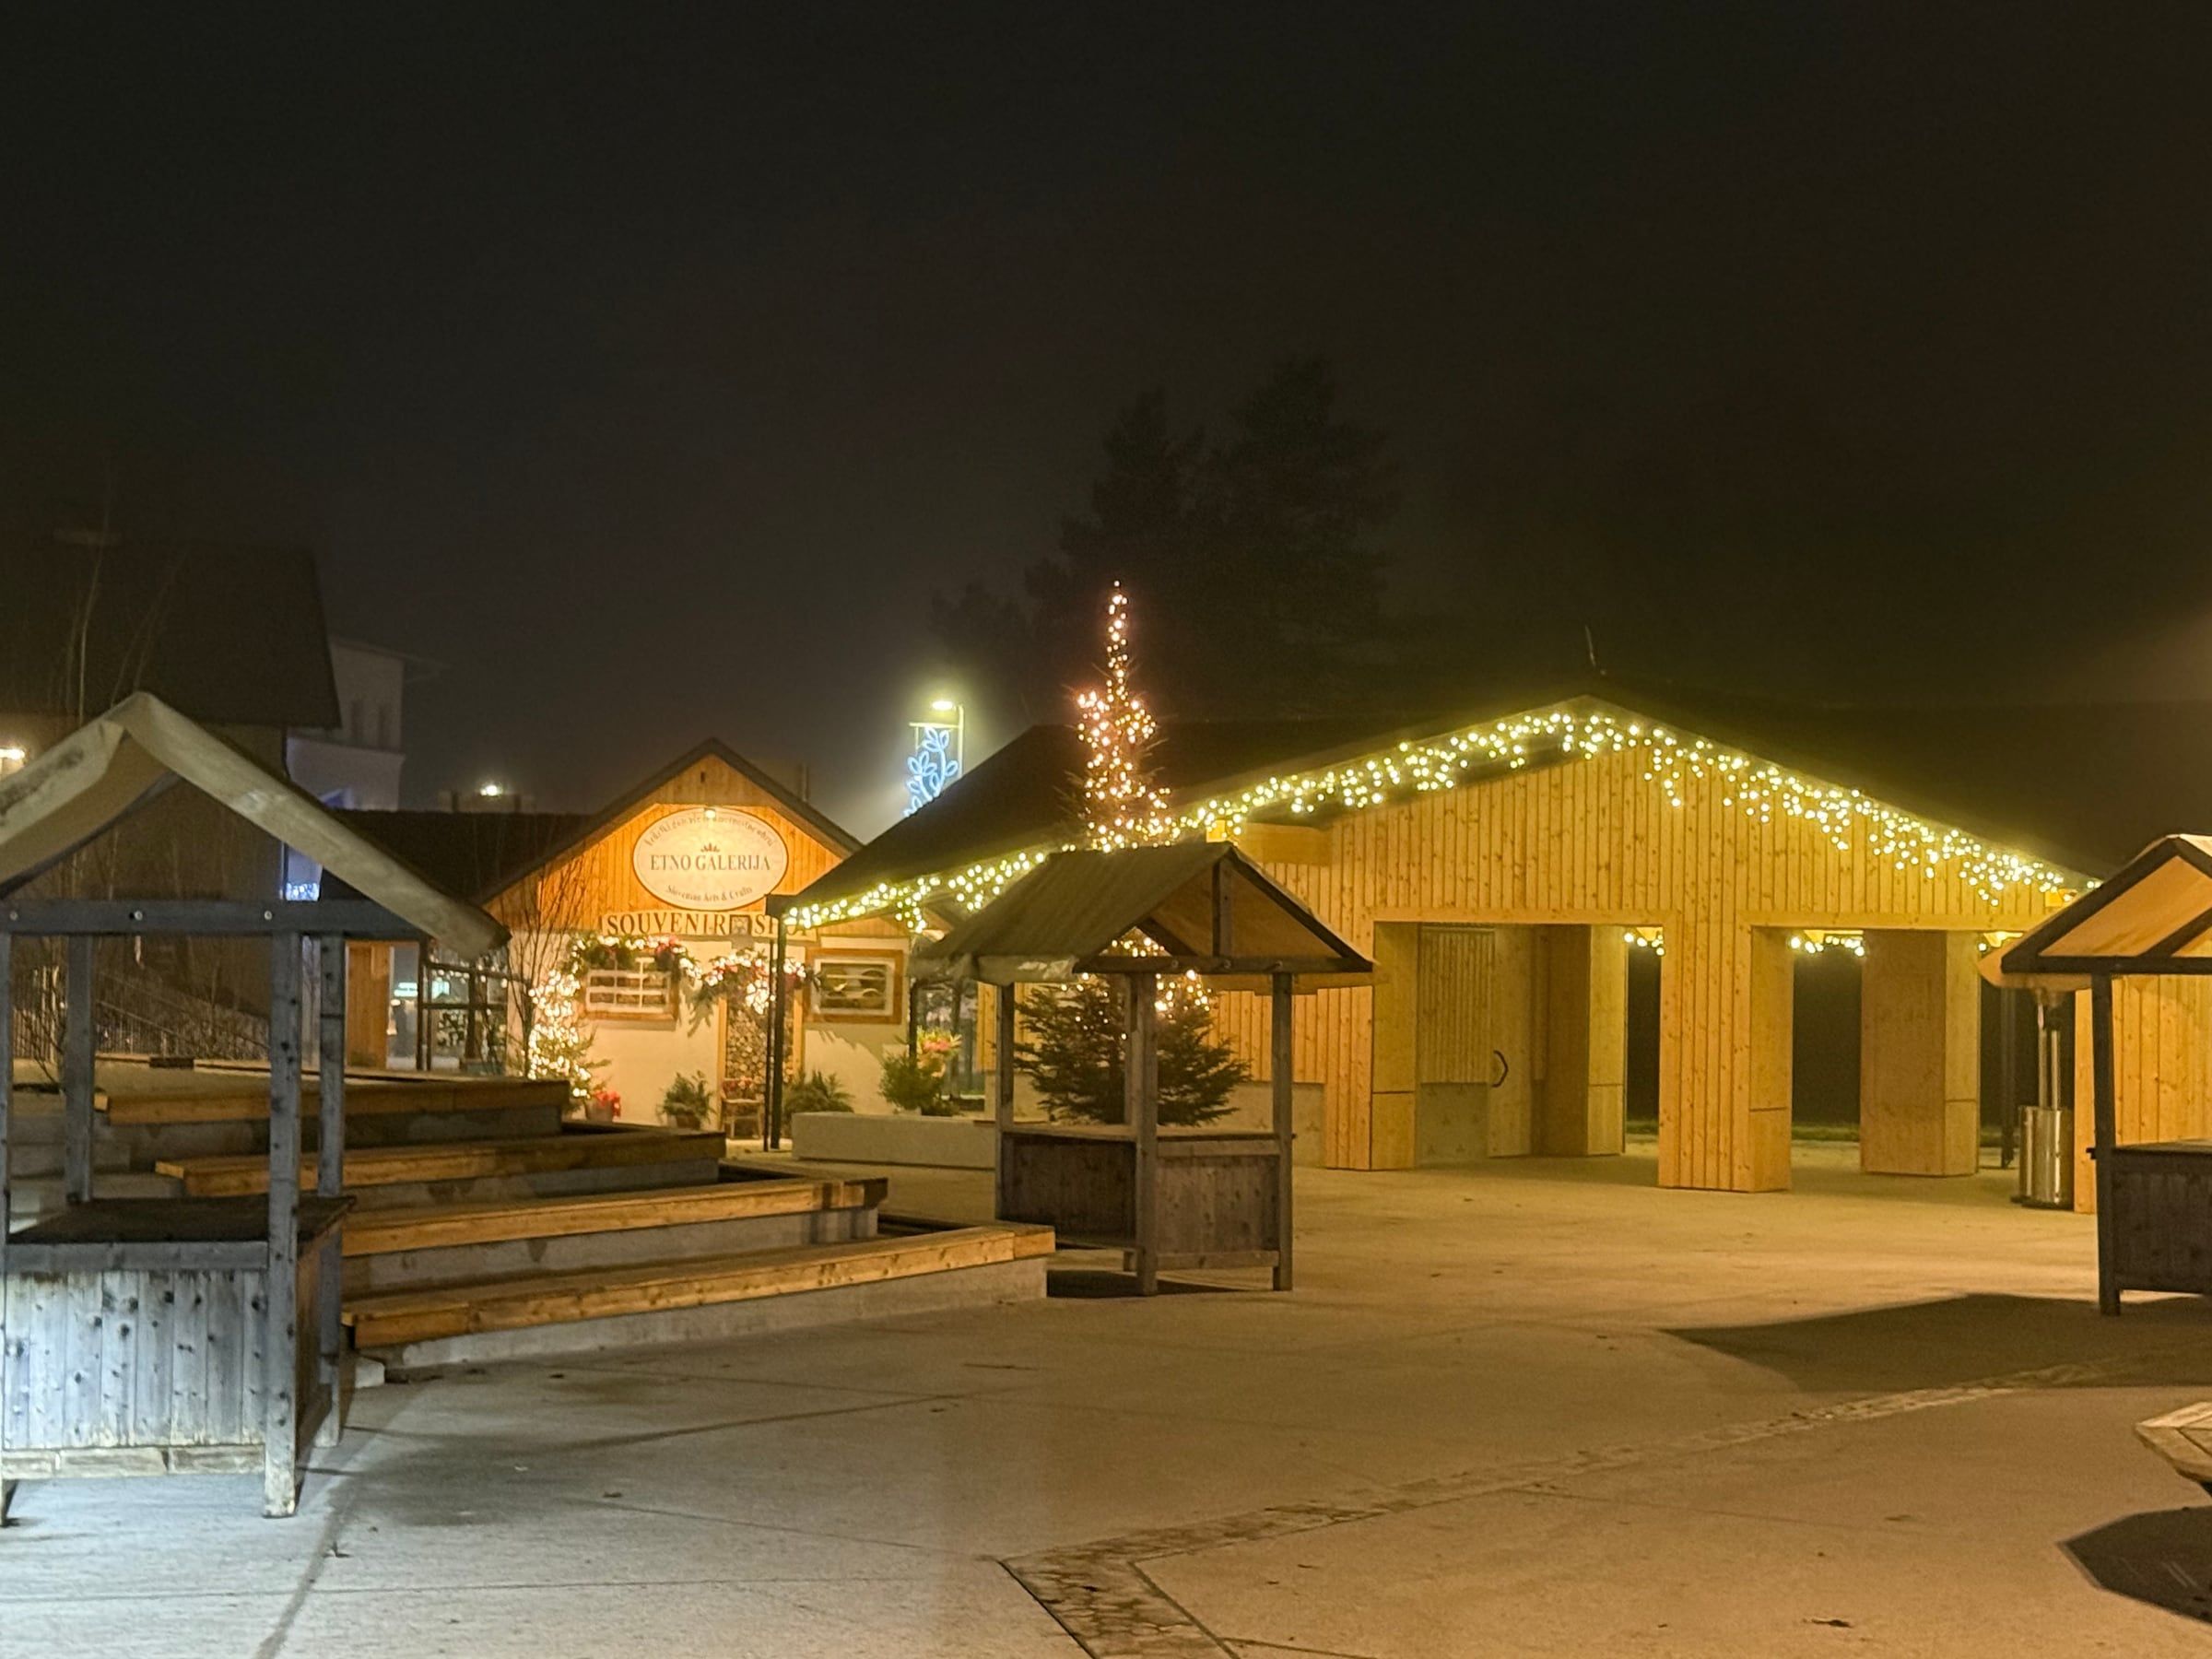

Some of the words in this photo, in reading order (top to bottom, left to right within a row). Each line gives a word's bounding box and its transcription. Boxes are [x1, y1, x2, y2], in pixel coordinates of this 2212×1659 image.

[650, 854, 691, 871] ETNO
[695, 854, 771, 871] GALERIJA
[703, 892, 720, 902] Arts
[721, 891, 727, 900] &
[729, 887, 753, 900] Crafts
[606, 912, 726, 936] SOUVENIR
